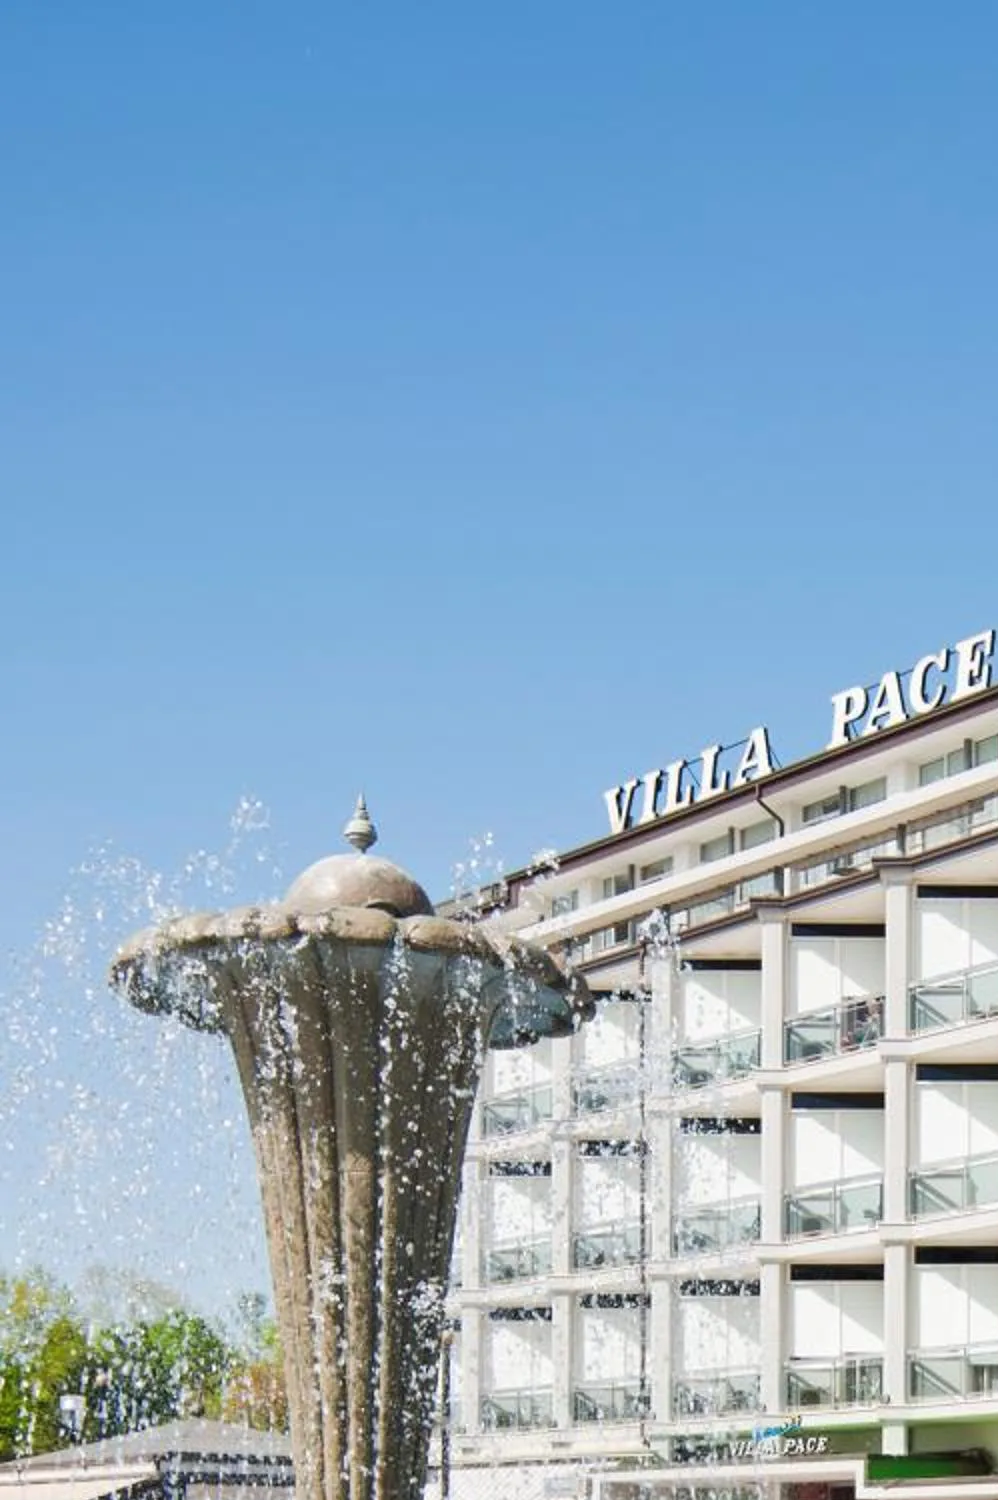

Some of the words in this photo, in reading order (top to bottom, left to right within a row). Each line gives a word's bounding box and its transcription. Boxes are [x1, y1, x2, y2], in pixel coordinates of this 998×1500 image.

[604, 726, 774, 834] VILLA
[826, 629, 996, 750] PACE
[783, 1437, 828, 1455] PACE
